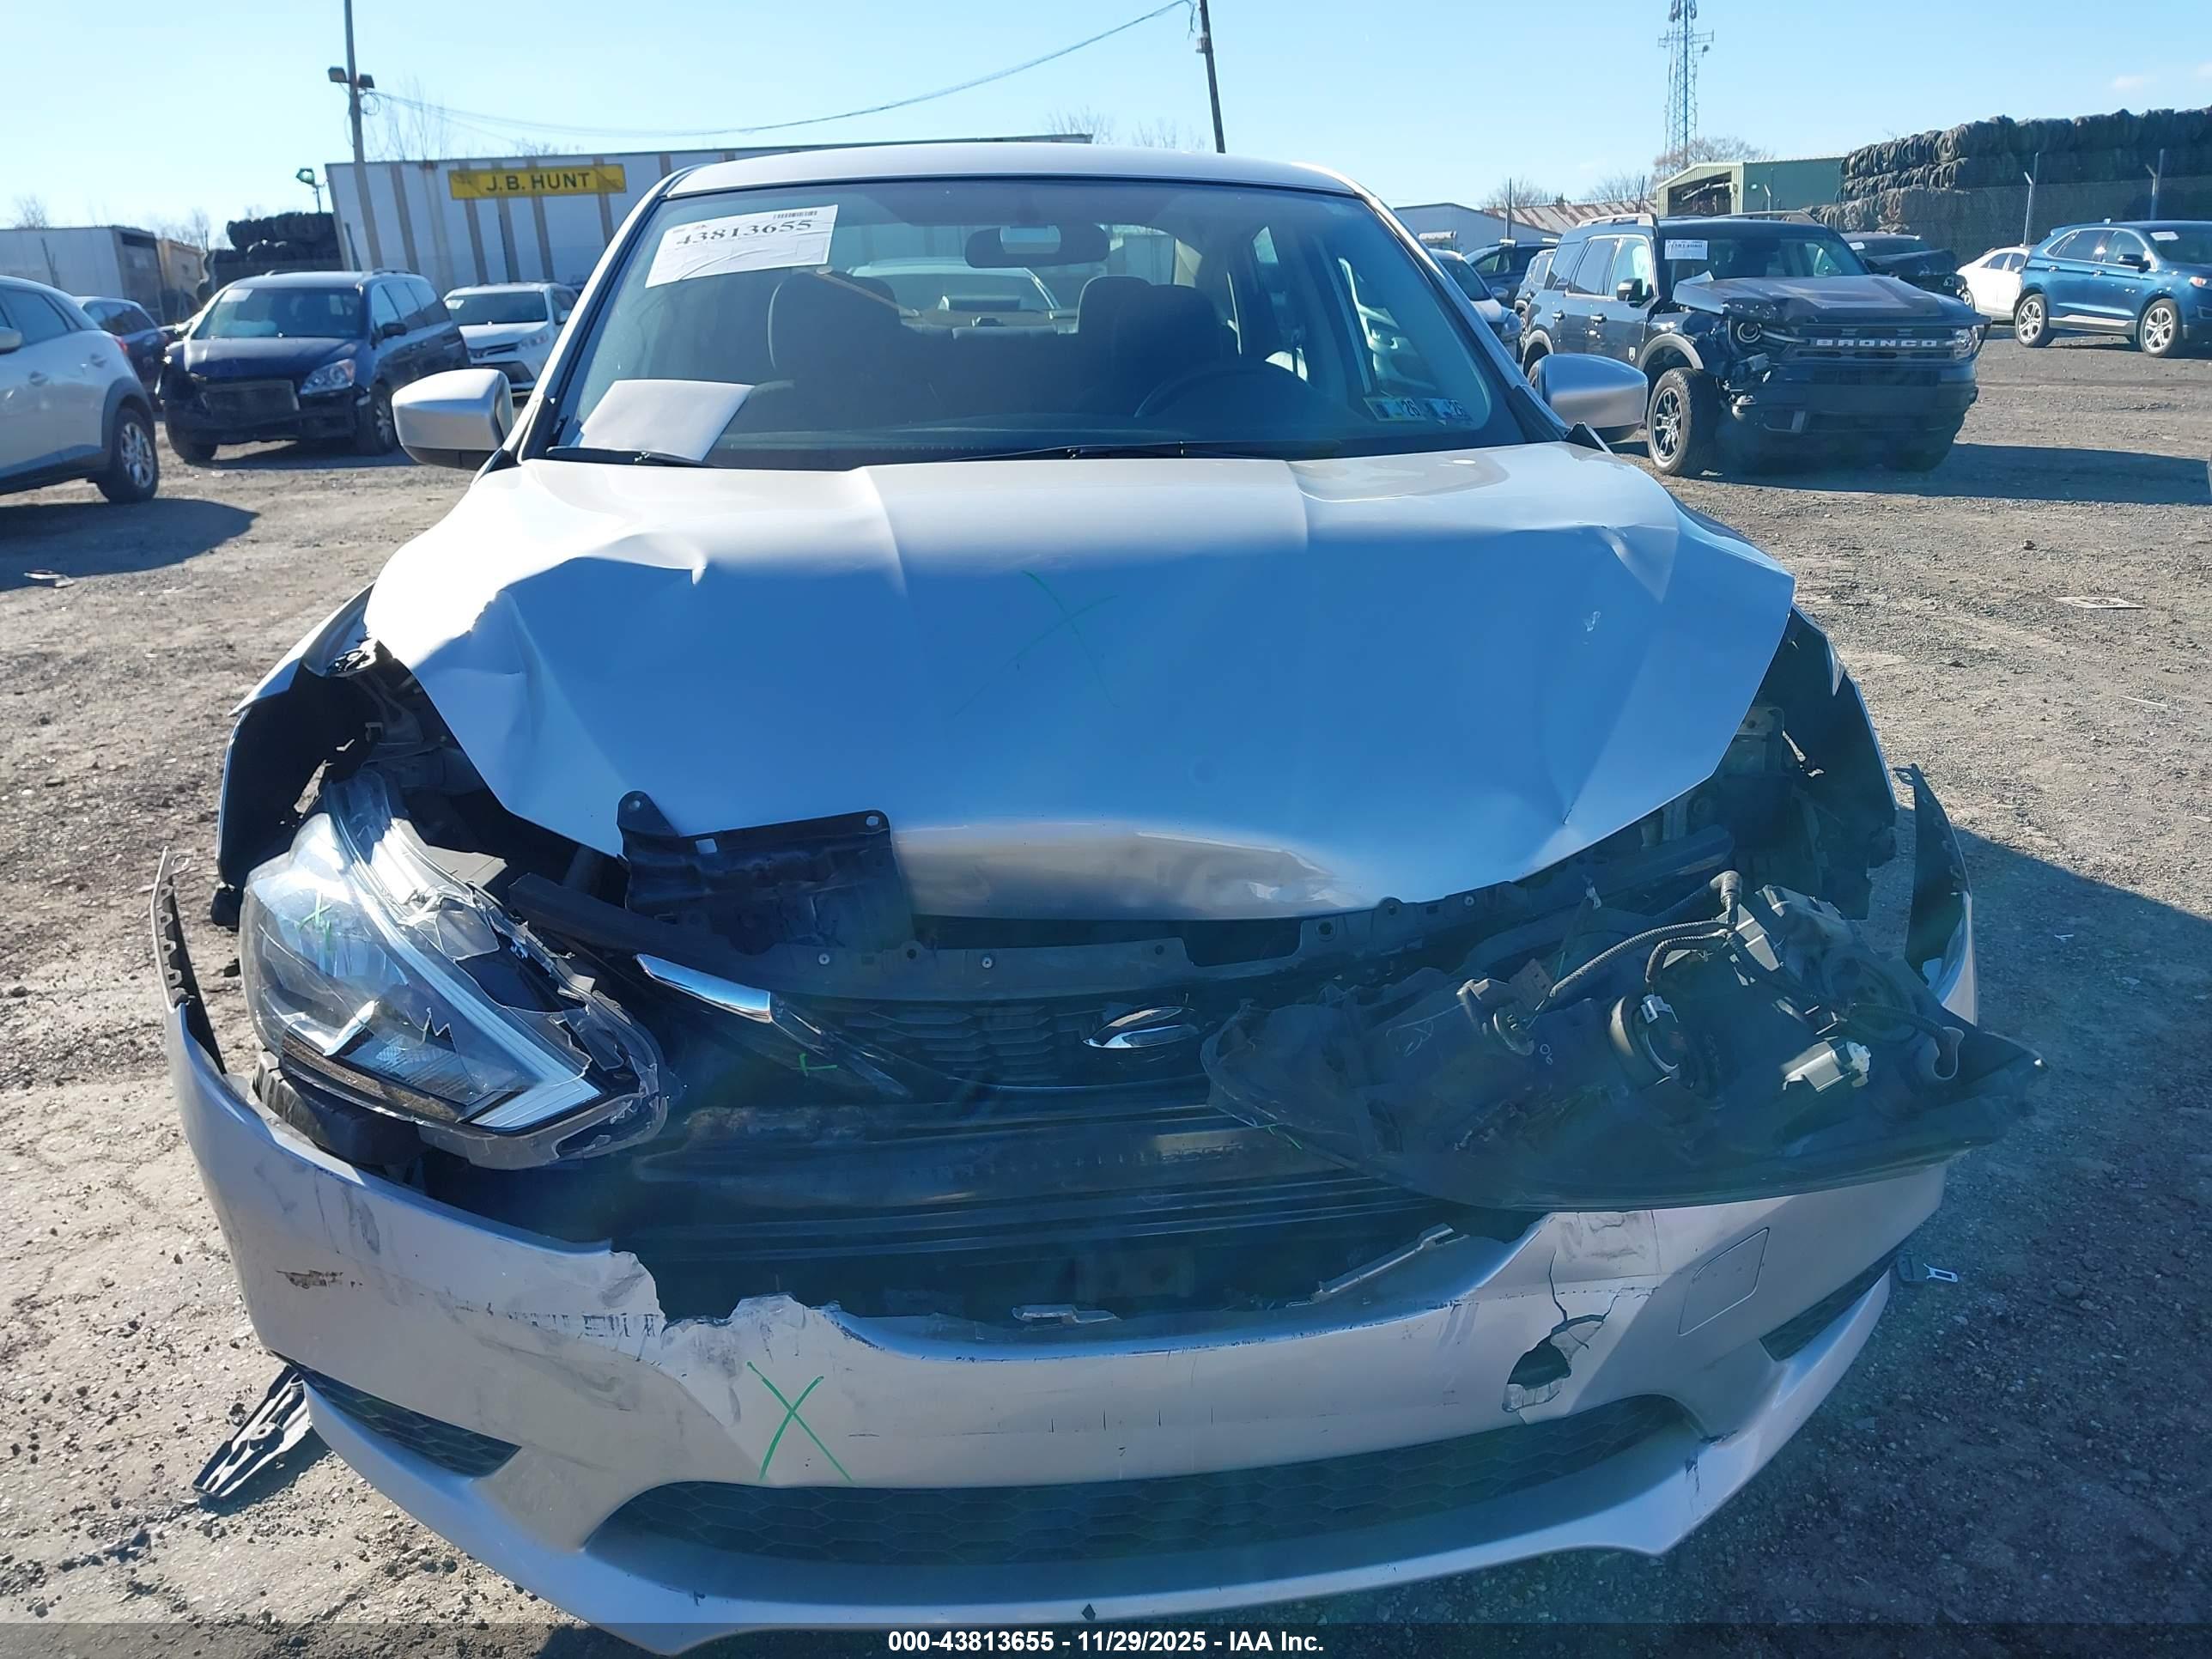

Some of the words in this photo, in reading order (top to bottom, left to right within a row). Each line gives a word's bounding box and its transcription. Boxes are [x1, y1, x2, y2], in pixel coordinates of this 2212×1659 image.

[486, 175, 526, 191] J.B.
[531, 173, 591, 190] HUNT
[676, 219, 814, 246] 43813655
[1815, 338, 1938, 348] BRONCO
